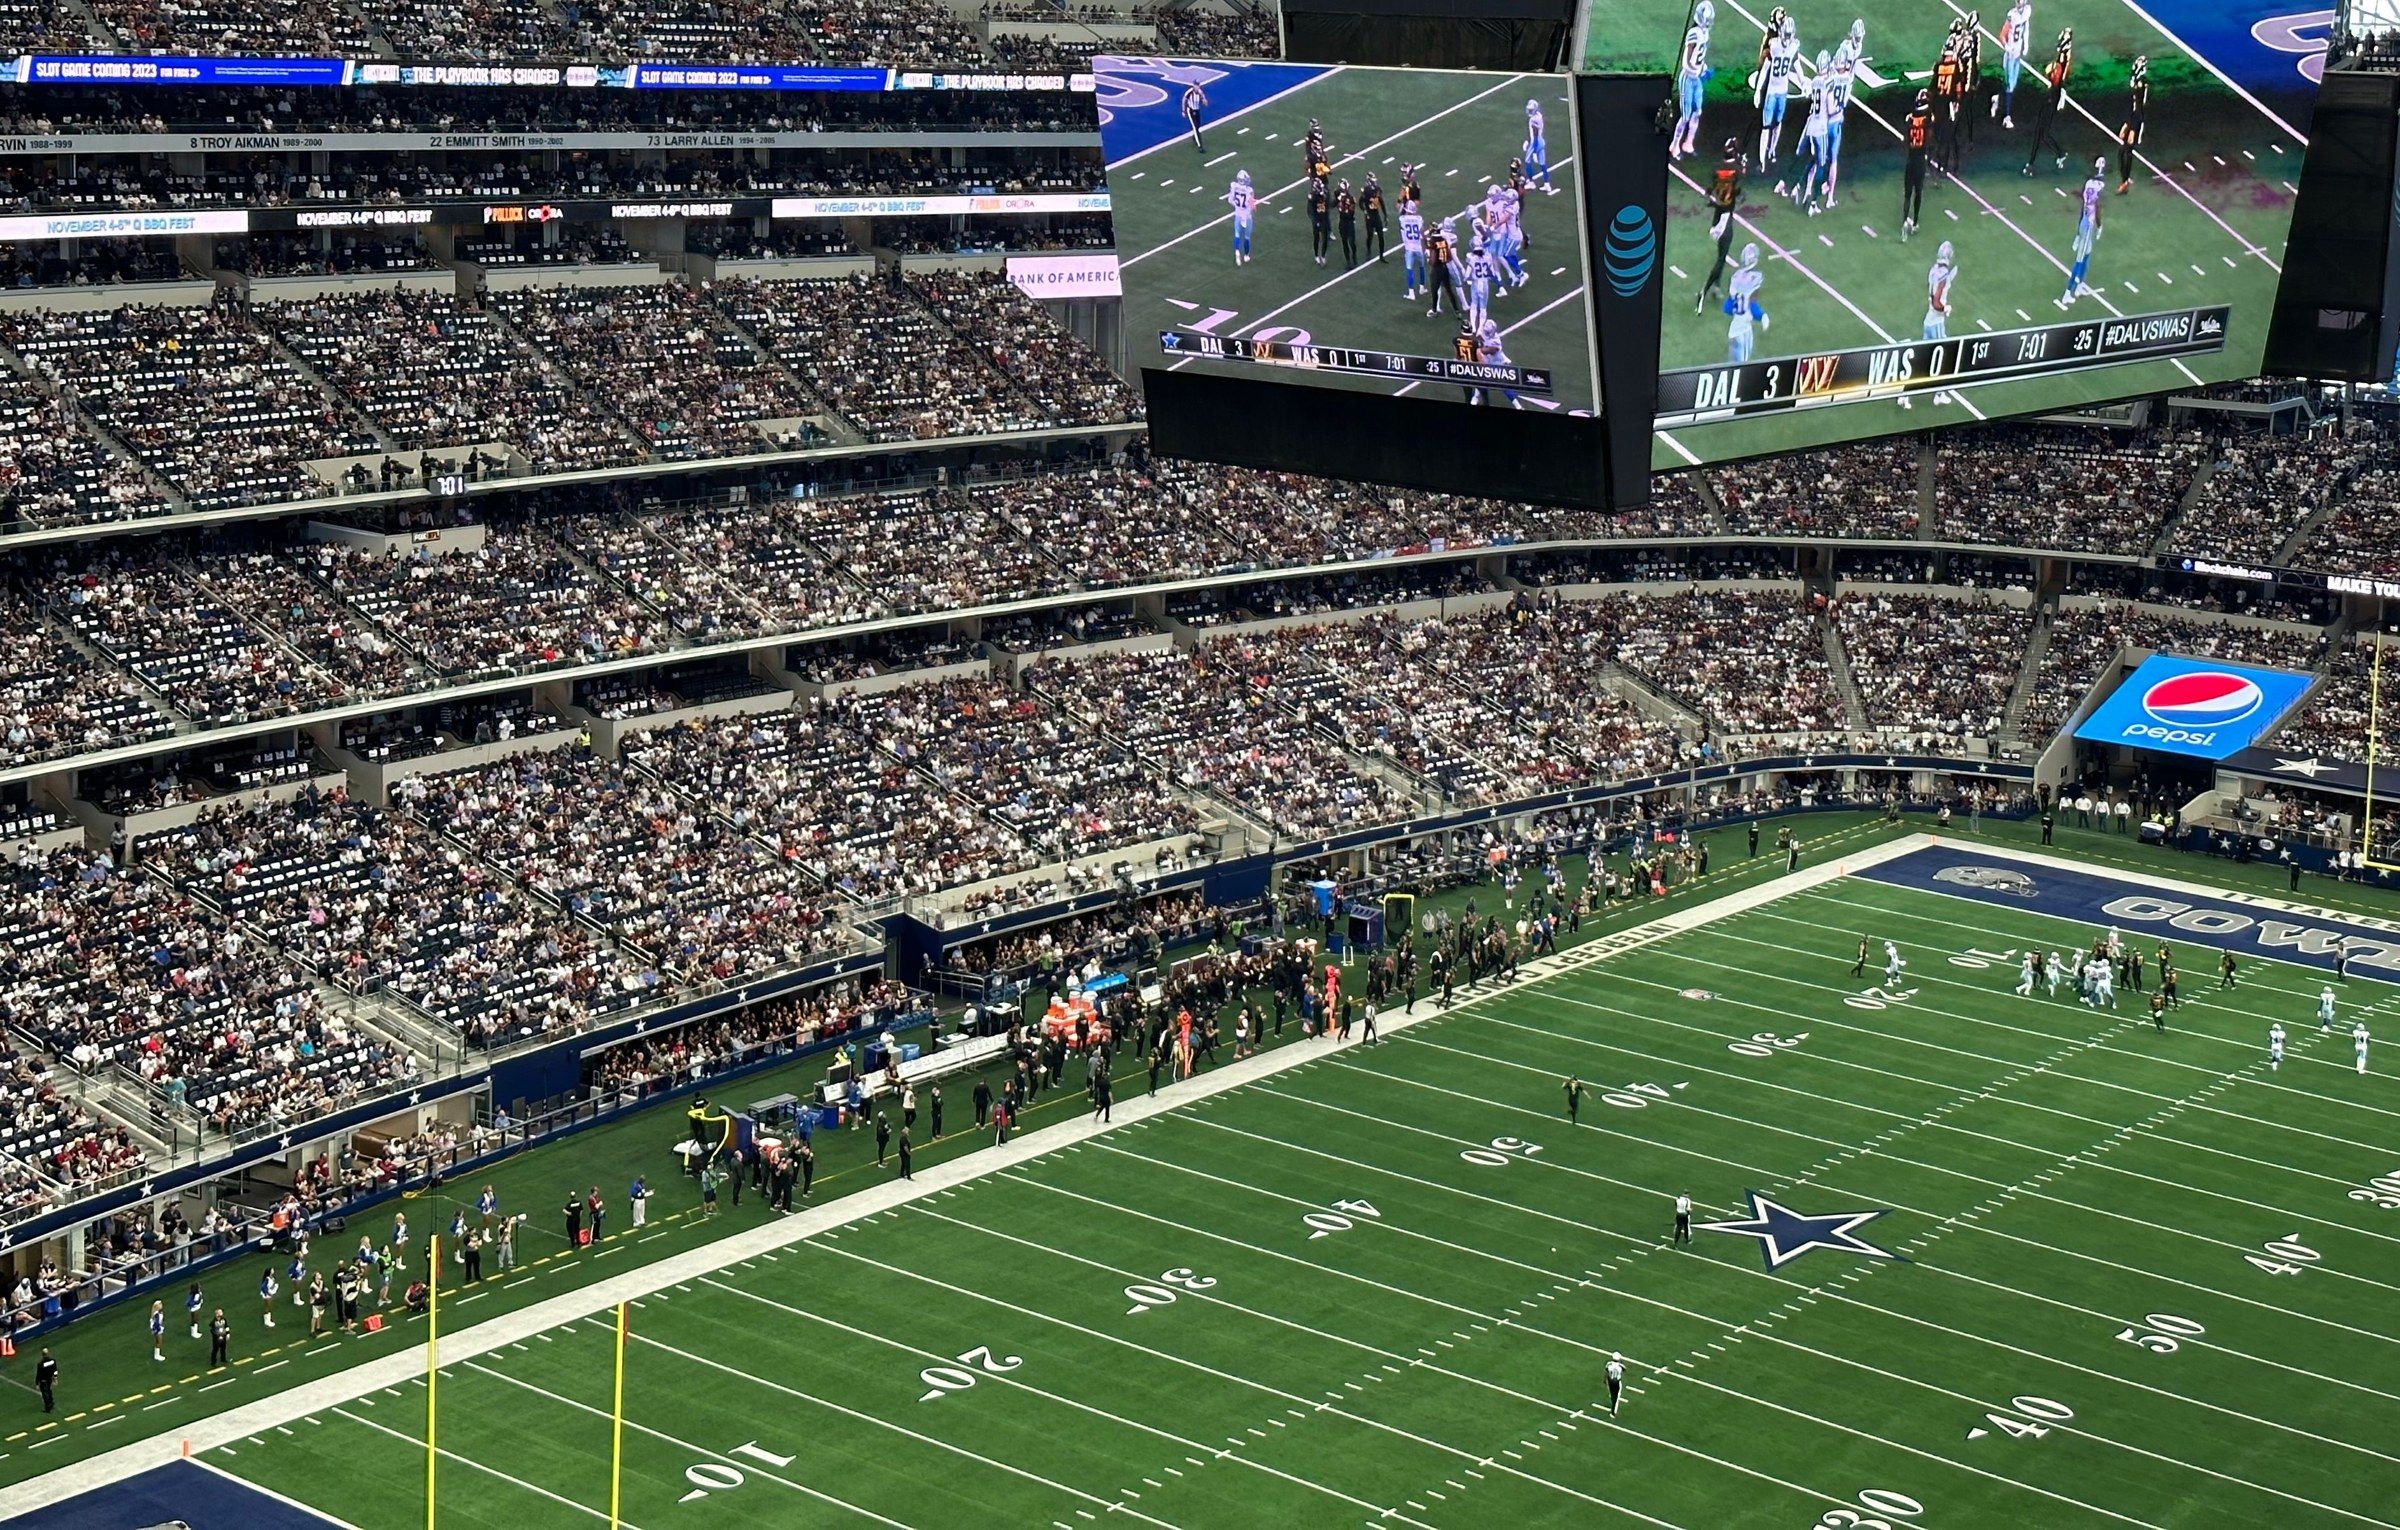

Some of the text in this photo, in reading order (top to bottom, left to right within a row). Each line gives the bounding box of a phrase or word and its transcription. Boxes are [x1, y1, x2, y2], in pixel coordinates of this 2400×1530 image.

[36, 63, 60, 77] SLOT
[62, 63, 91, 77] GAME
[93, 63, 130, 77] COMING
[132, 63, 157, 78] 2023
[412, 67, 433, 83] THE
[435, 68, 489, 84] PLAYBOOK
[490, 68, 512, 84] HAS
[513, 68, 560, 84] CHANGED
[641, 71, 660, 83] SLOT
[662, 71, 685, 84] GAME
[686, 72, 716, 84] COMING
[718, 72, 737, 84] 2023
[942, 74, 960, 88] THE
[962, 75, 1005, 89] PLAYBOOK
[1025, 76, 1064, 89] CHANGED
[30, 139, 73, 149] 1988-1999
[190, 138, 198, 149] 8
[200, 137, 231, 149] TROY
[235, 137, 280, 149] AIKMAN
[430, 135, 442, 147] 22
[446, 135, 489, 147] EMMITT
[492, 135, 525, 147] SMITH
[647, 135, 661, 147] 73
[664, 135, 700, 147] LARRY
[701, 135, 734, 147] ALLEN
[296, 210, 352, 226] NOVEMBER
[374, 211, 384, 225] Q
[385, 211, 406, 224] BBQ
[407, 210, 432, 223] FEST
[612, 205, 661, 217] NOVEMBER
[681, 205, 689, 216] Q
[690, 204, 710, 216] BBQ
[710, 203, 733, 215] FEST
[815, 202, 860, 212] NOVEMBER
[887, 202, 904, 211] BBQ
[906, 201, 926, 211] FEST
[47, 219, 107, 233] NOVEMBER
[133, 218, 141, 230] Q
[144, 218, 167, 230] BBQ
[169, 217, 195, 229] FEST
[1405, 224, 1420, 240] 29
[1010, 271, 1119, 284] BANK OF AMERIC
[1200, 337, 1225, 355] DAL
[1235, 340, 1244, 356] 3
[1291, 346, 1320, 364] WAS
[1329, 350, 1338, 366] 0
[1354, 353, 1366, 365] 1ST
[1385, 355, 1406, 371] 7:01
[1426, 361, 1440, 373] :25
[1449, 363, 1517, 381] #DALVSWAS
[1694, 369, 1741, 409] DAL
[1763, 365, 1780, 400] 3
[1868, 347, 1915, 385] WAS
[1930, 345, 1944, 377] 0
[1971, 341, 1990, 365] 1ST
[2017, 332, 2047, 361] 7:01
[2073, 329, 2093, 351] :25
[2105, 316, 2189, 346] #DALVSWAS
[2194, 560, 2272, 580] Blockchain.com
[2327, 576, 2373, 594] MAKE
[2122, 723, 2217, 747] pepsi
[1540, 922, 1680, 969] INTERCEPT
[1946, 946, 2010, 969] 10
[1843, 987, 1910, 1010] 20
[1727, 1032, 1798, 1057] 30
[1601, 1081, 1671, 1109] 40
[1460, 1136, 1543, 1166] 50
[2347, 1177, 2400, 1209] 30
[1302, 1198, 1382, 1233] 40
[2244, 1241, 2321, 1276] 40
[1123, 1267, 1218, 1305] 30
[2115, 1313, 2205, 1353] 50
[919, 1345, 1024, 1390] 20
[1984, 1395, 2074, 1439] 40
[684, 1440, 797, 1490] 10
[1822, 1489, 1924, 1530] 30
